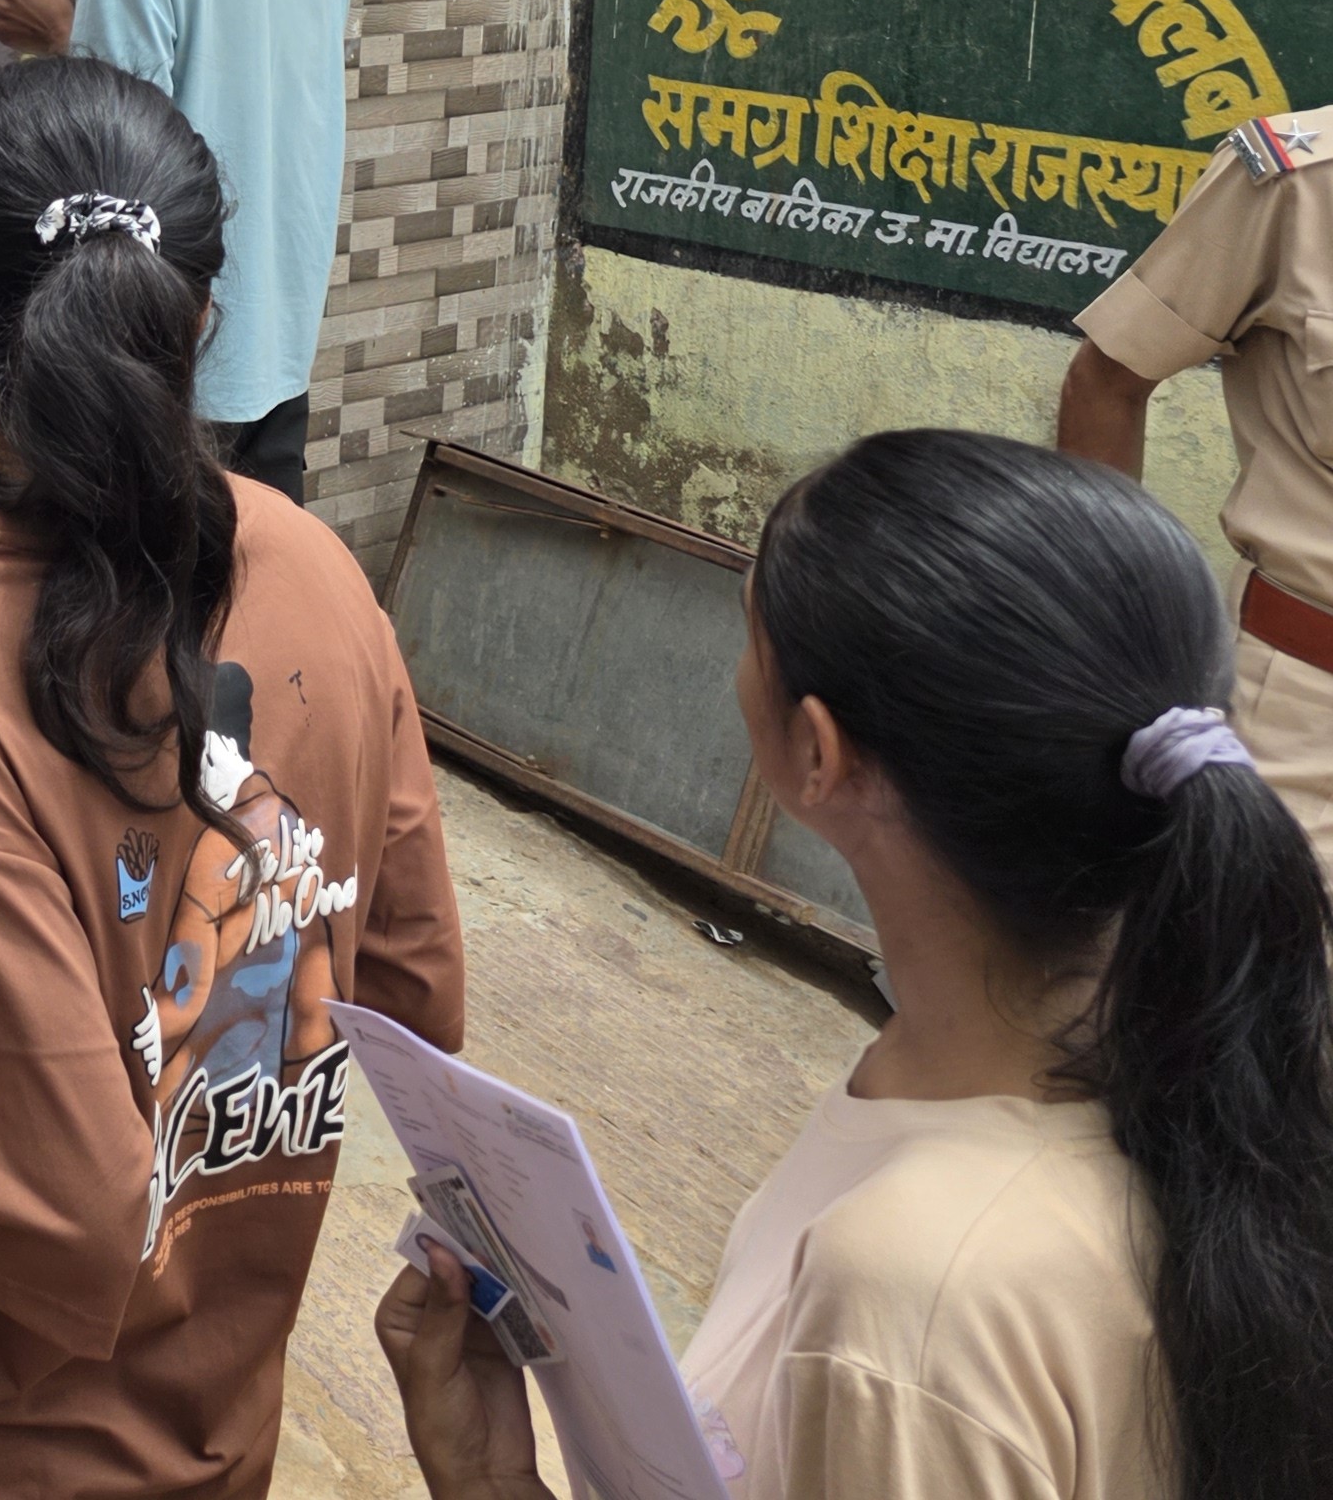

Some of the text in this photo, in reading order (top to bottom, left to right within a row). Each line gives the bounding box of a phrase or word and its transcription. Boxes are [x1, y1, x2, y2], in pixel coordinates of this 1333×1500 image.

[642, 74, 811, 170] समग्र
[812, 70, 981, 204] शिक्षा
[611, 158, 742, 217] राजकीय
[740, 177, 875, 239] बालिका
[982, 212, 1129, 279] विद्यालय
[245, 884, 293, 956] No
[174, 1181, 280, 1223] RESPONSIBILITIES
[281, 1180, 313, 1195] ARE
